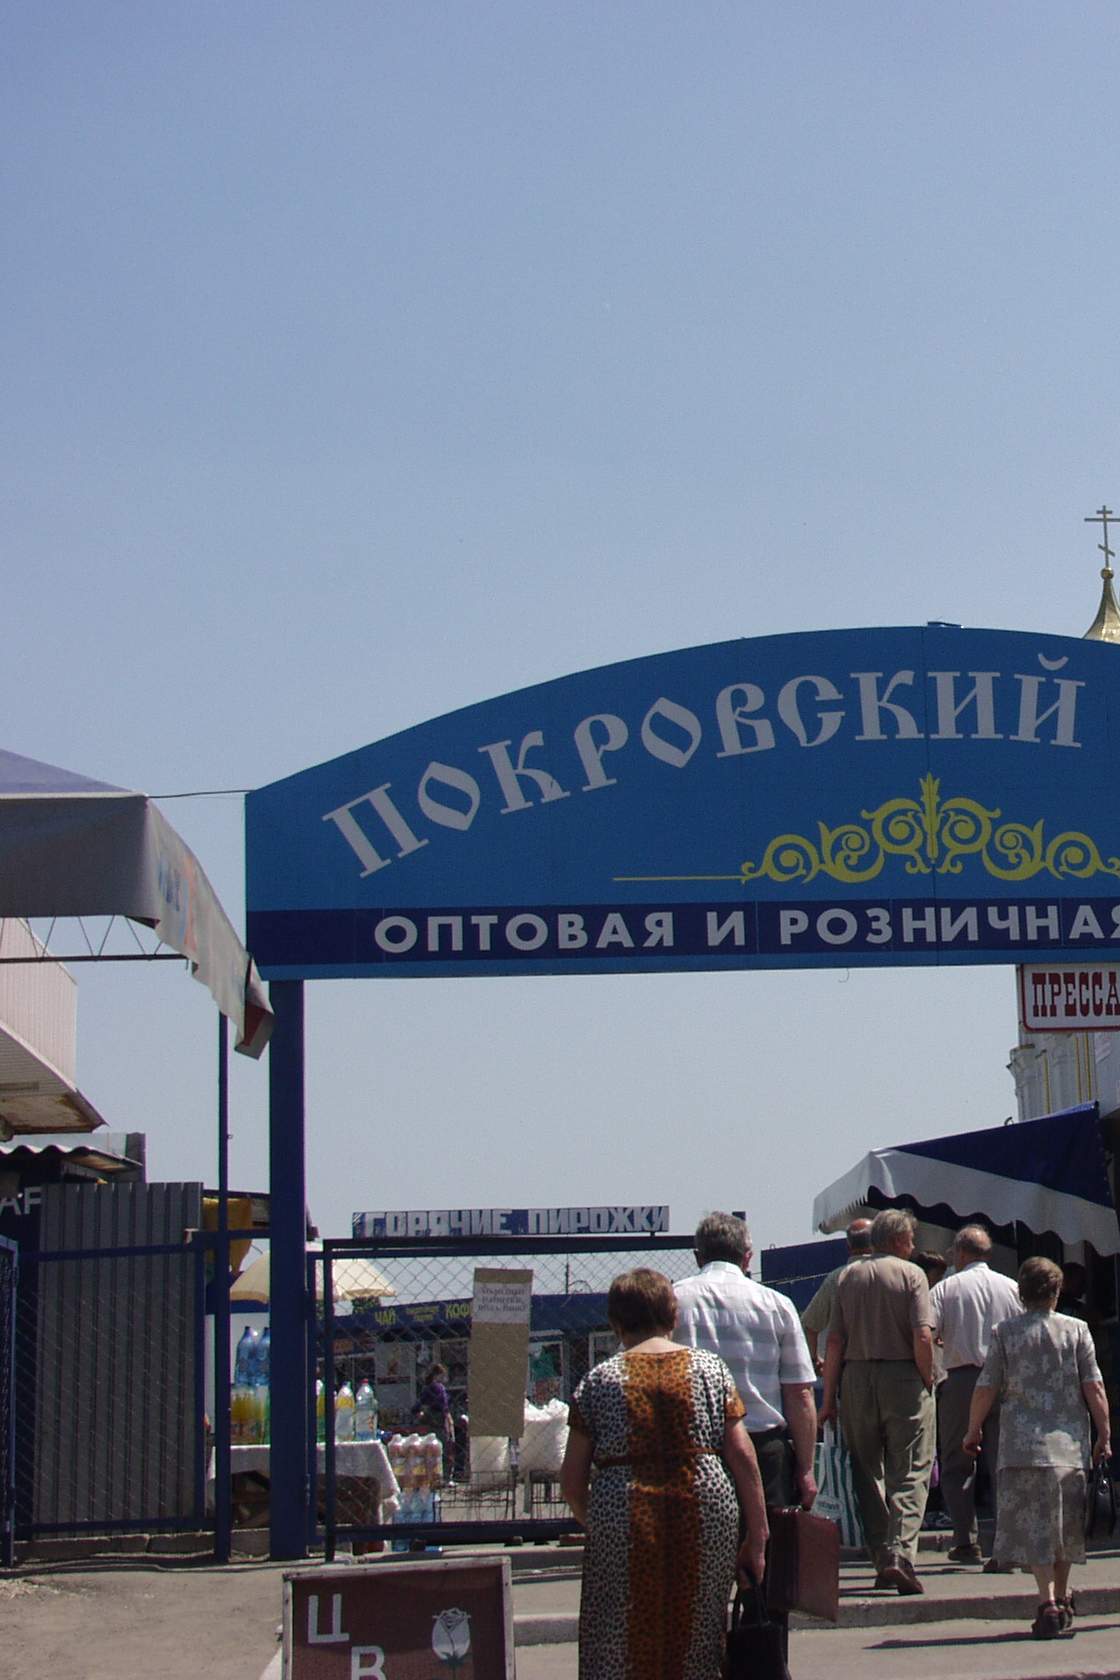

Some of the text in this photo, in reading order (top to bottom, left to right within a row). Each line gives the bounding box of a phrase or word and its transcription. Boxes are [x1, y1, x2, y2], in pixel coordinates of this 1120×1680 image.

[322, 652, 1086, 878] ПОКРОВСКИЙ
[373, 911, 674, 953] ОПТОВАЯ
[706, 910, 746, 947] И
[364, 1205, 670, 1237] ГОРЯЧИЕ ПИРОЖКИ
